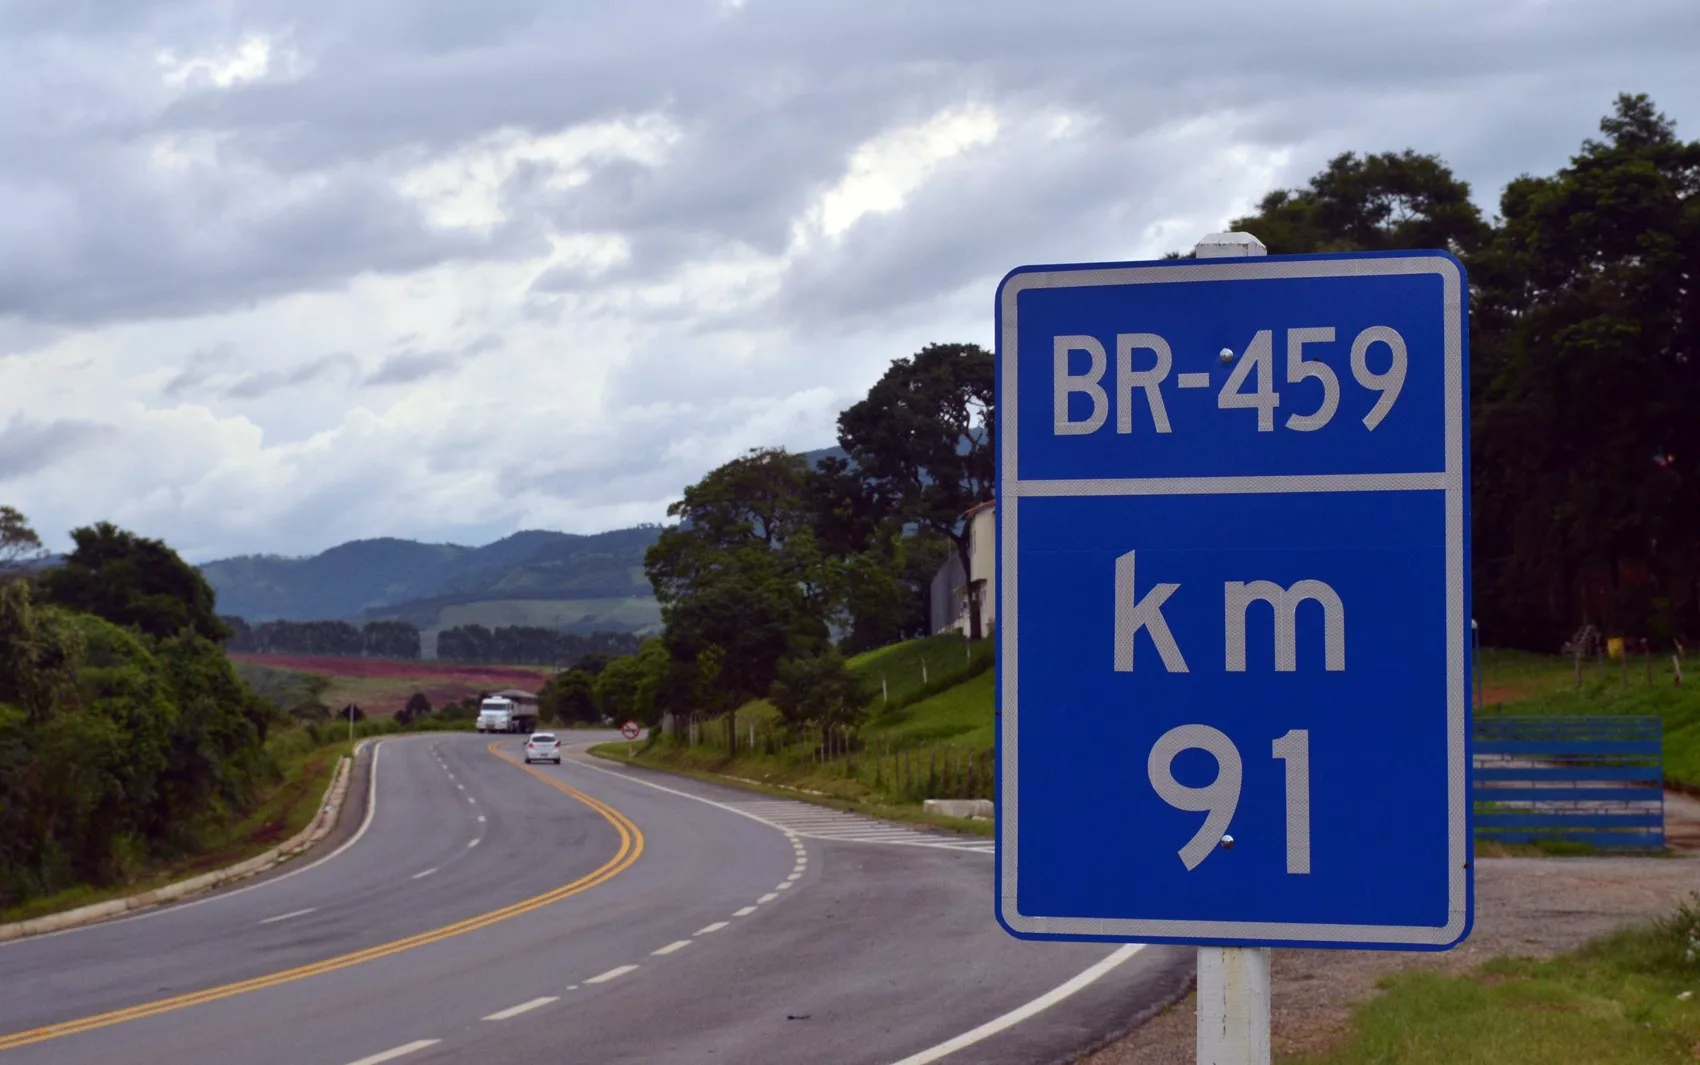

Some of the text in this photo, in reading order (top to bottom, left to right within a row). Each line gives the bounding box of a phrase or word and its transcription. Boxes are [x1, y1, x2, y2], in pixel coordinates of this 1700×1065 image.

[1053, 325, 1408, 436] BR-459
[1113, 549, 1346, 673] km
[1147, 724, 1311, 874] 91
